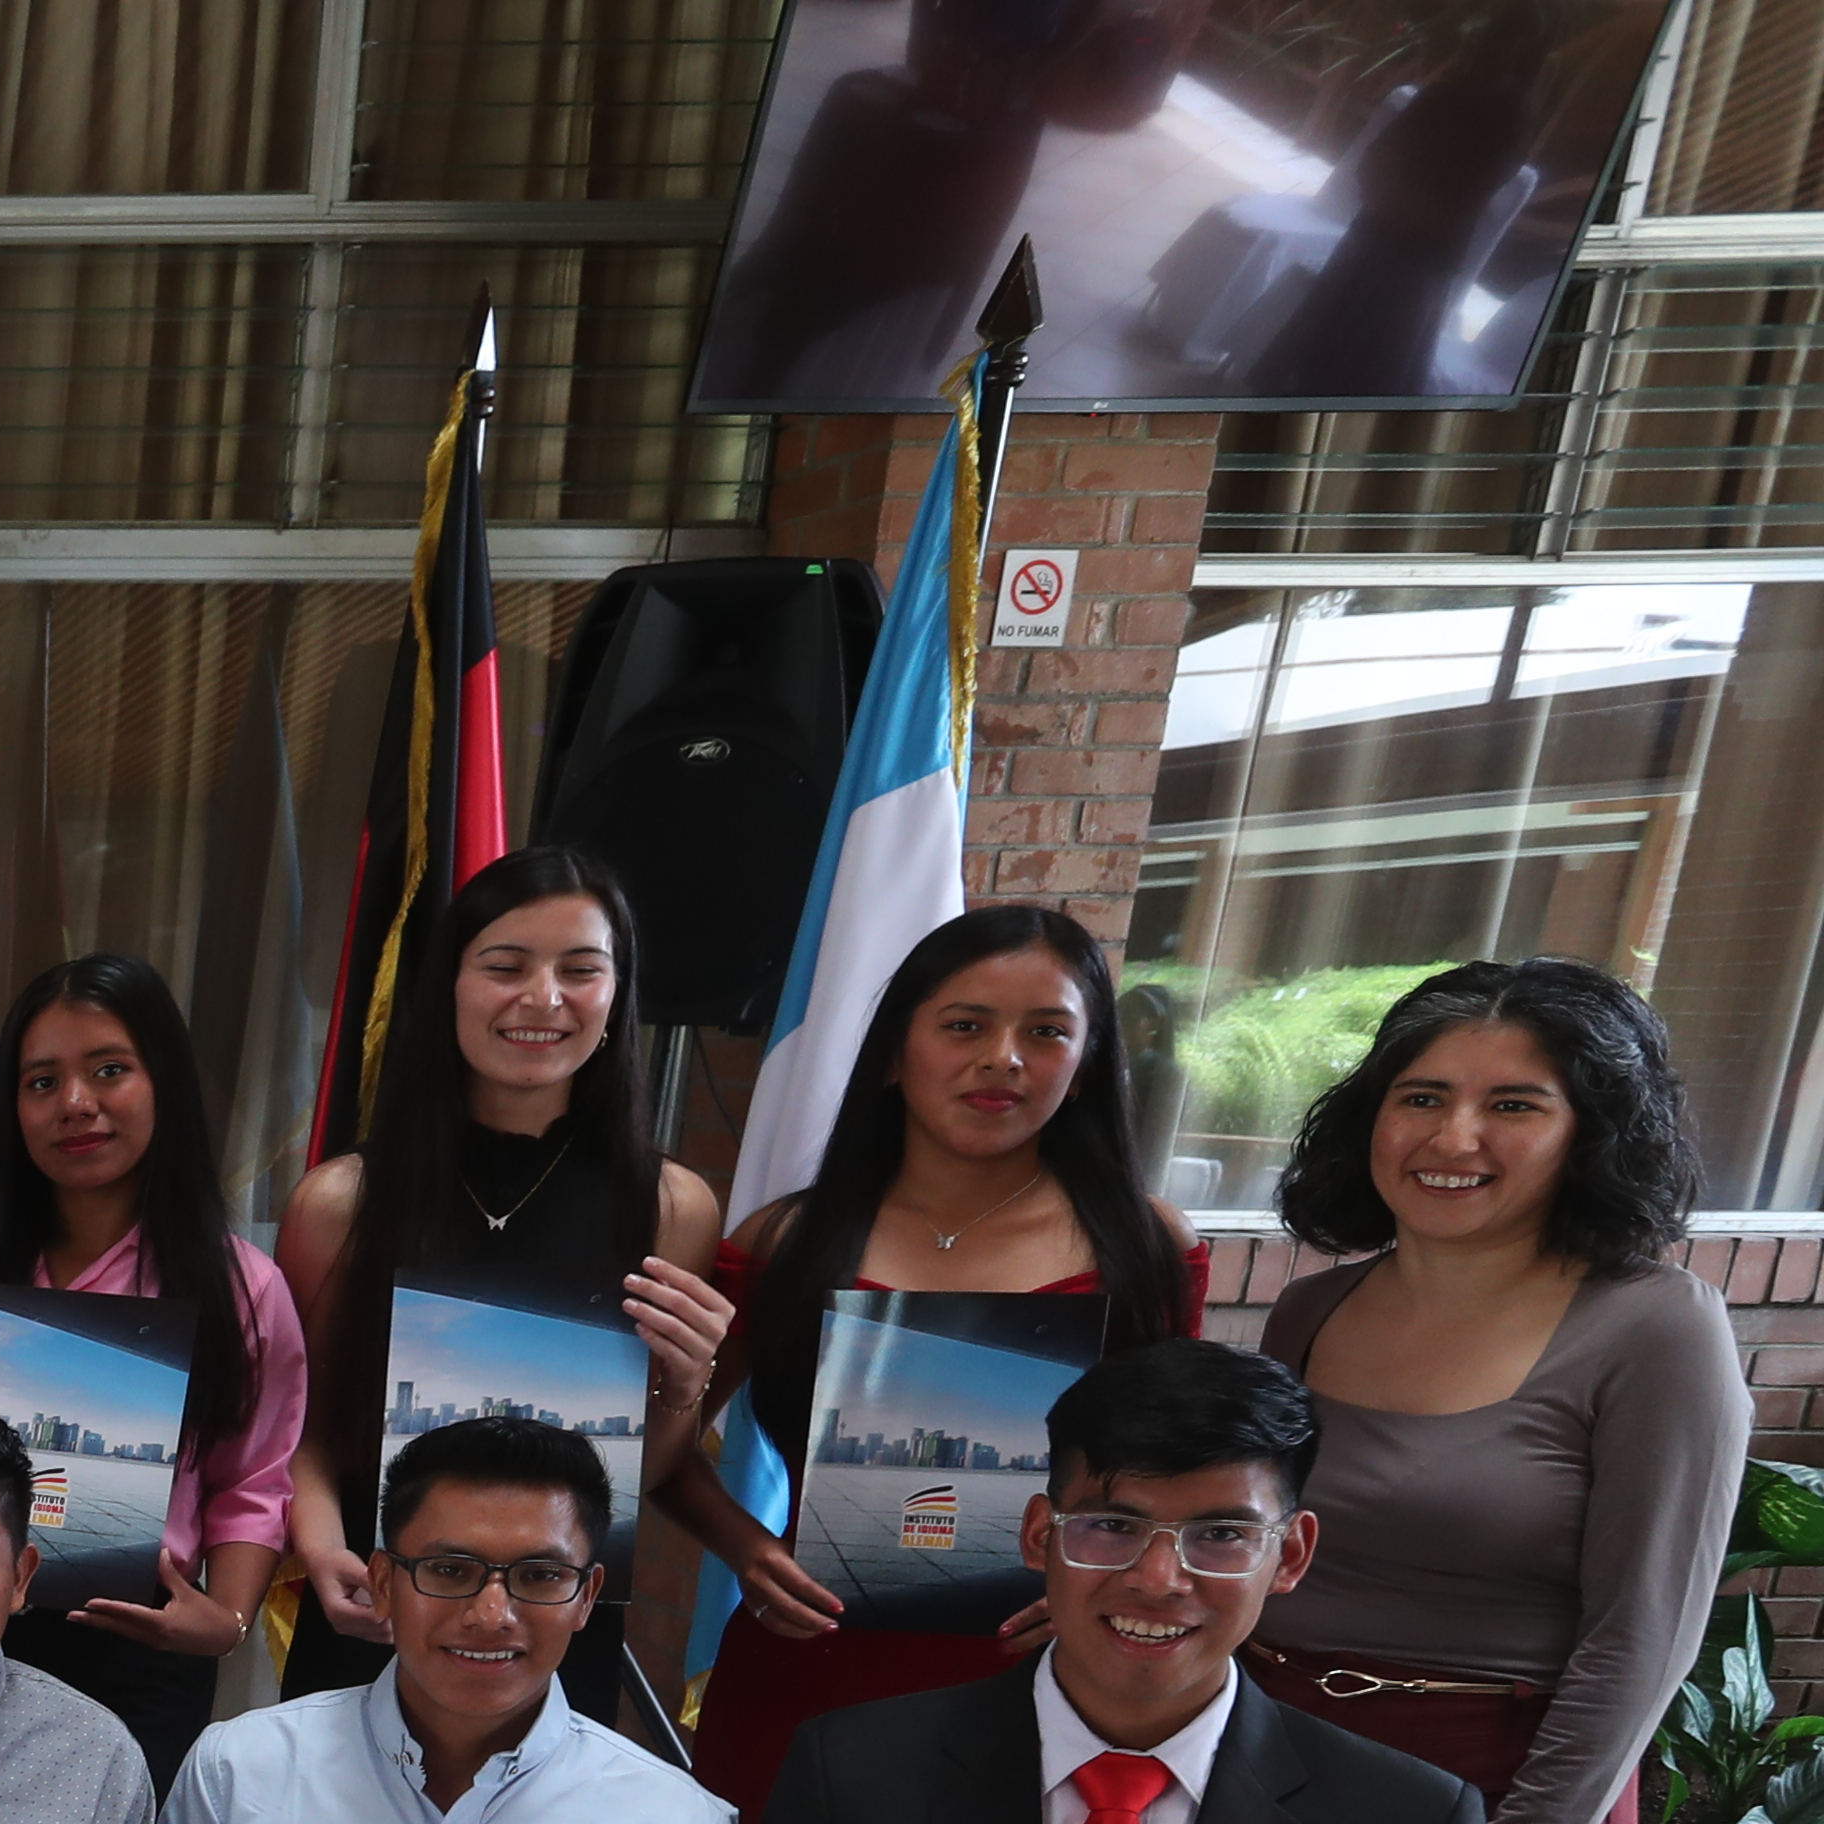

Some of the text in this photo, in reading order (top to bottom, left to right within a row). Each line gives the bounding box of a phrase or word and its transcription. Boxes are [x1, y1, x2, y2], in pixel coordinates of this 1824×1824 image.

[997, 625, 1060, 637] NO FUMAR
[34, 1503, 64, 1514] IDIOMA
[904, 1514, 955, 1525] INSTITUTO
[903, 1524, 954, 1535] DE IDIOMA
